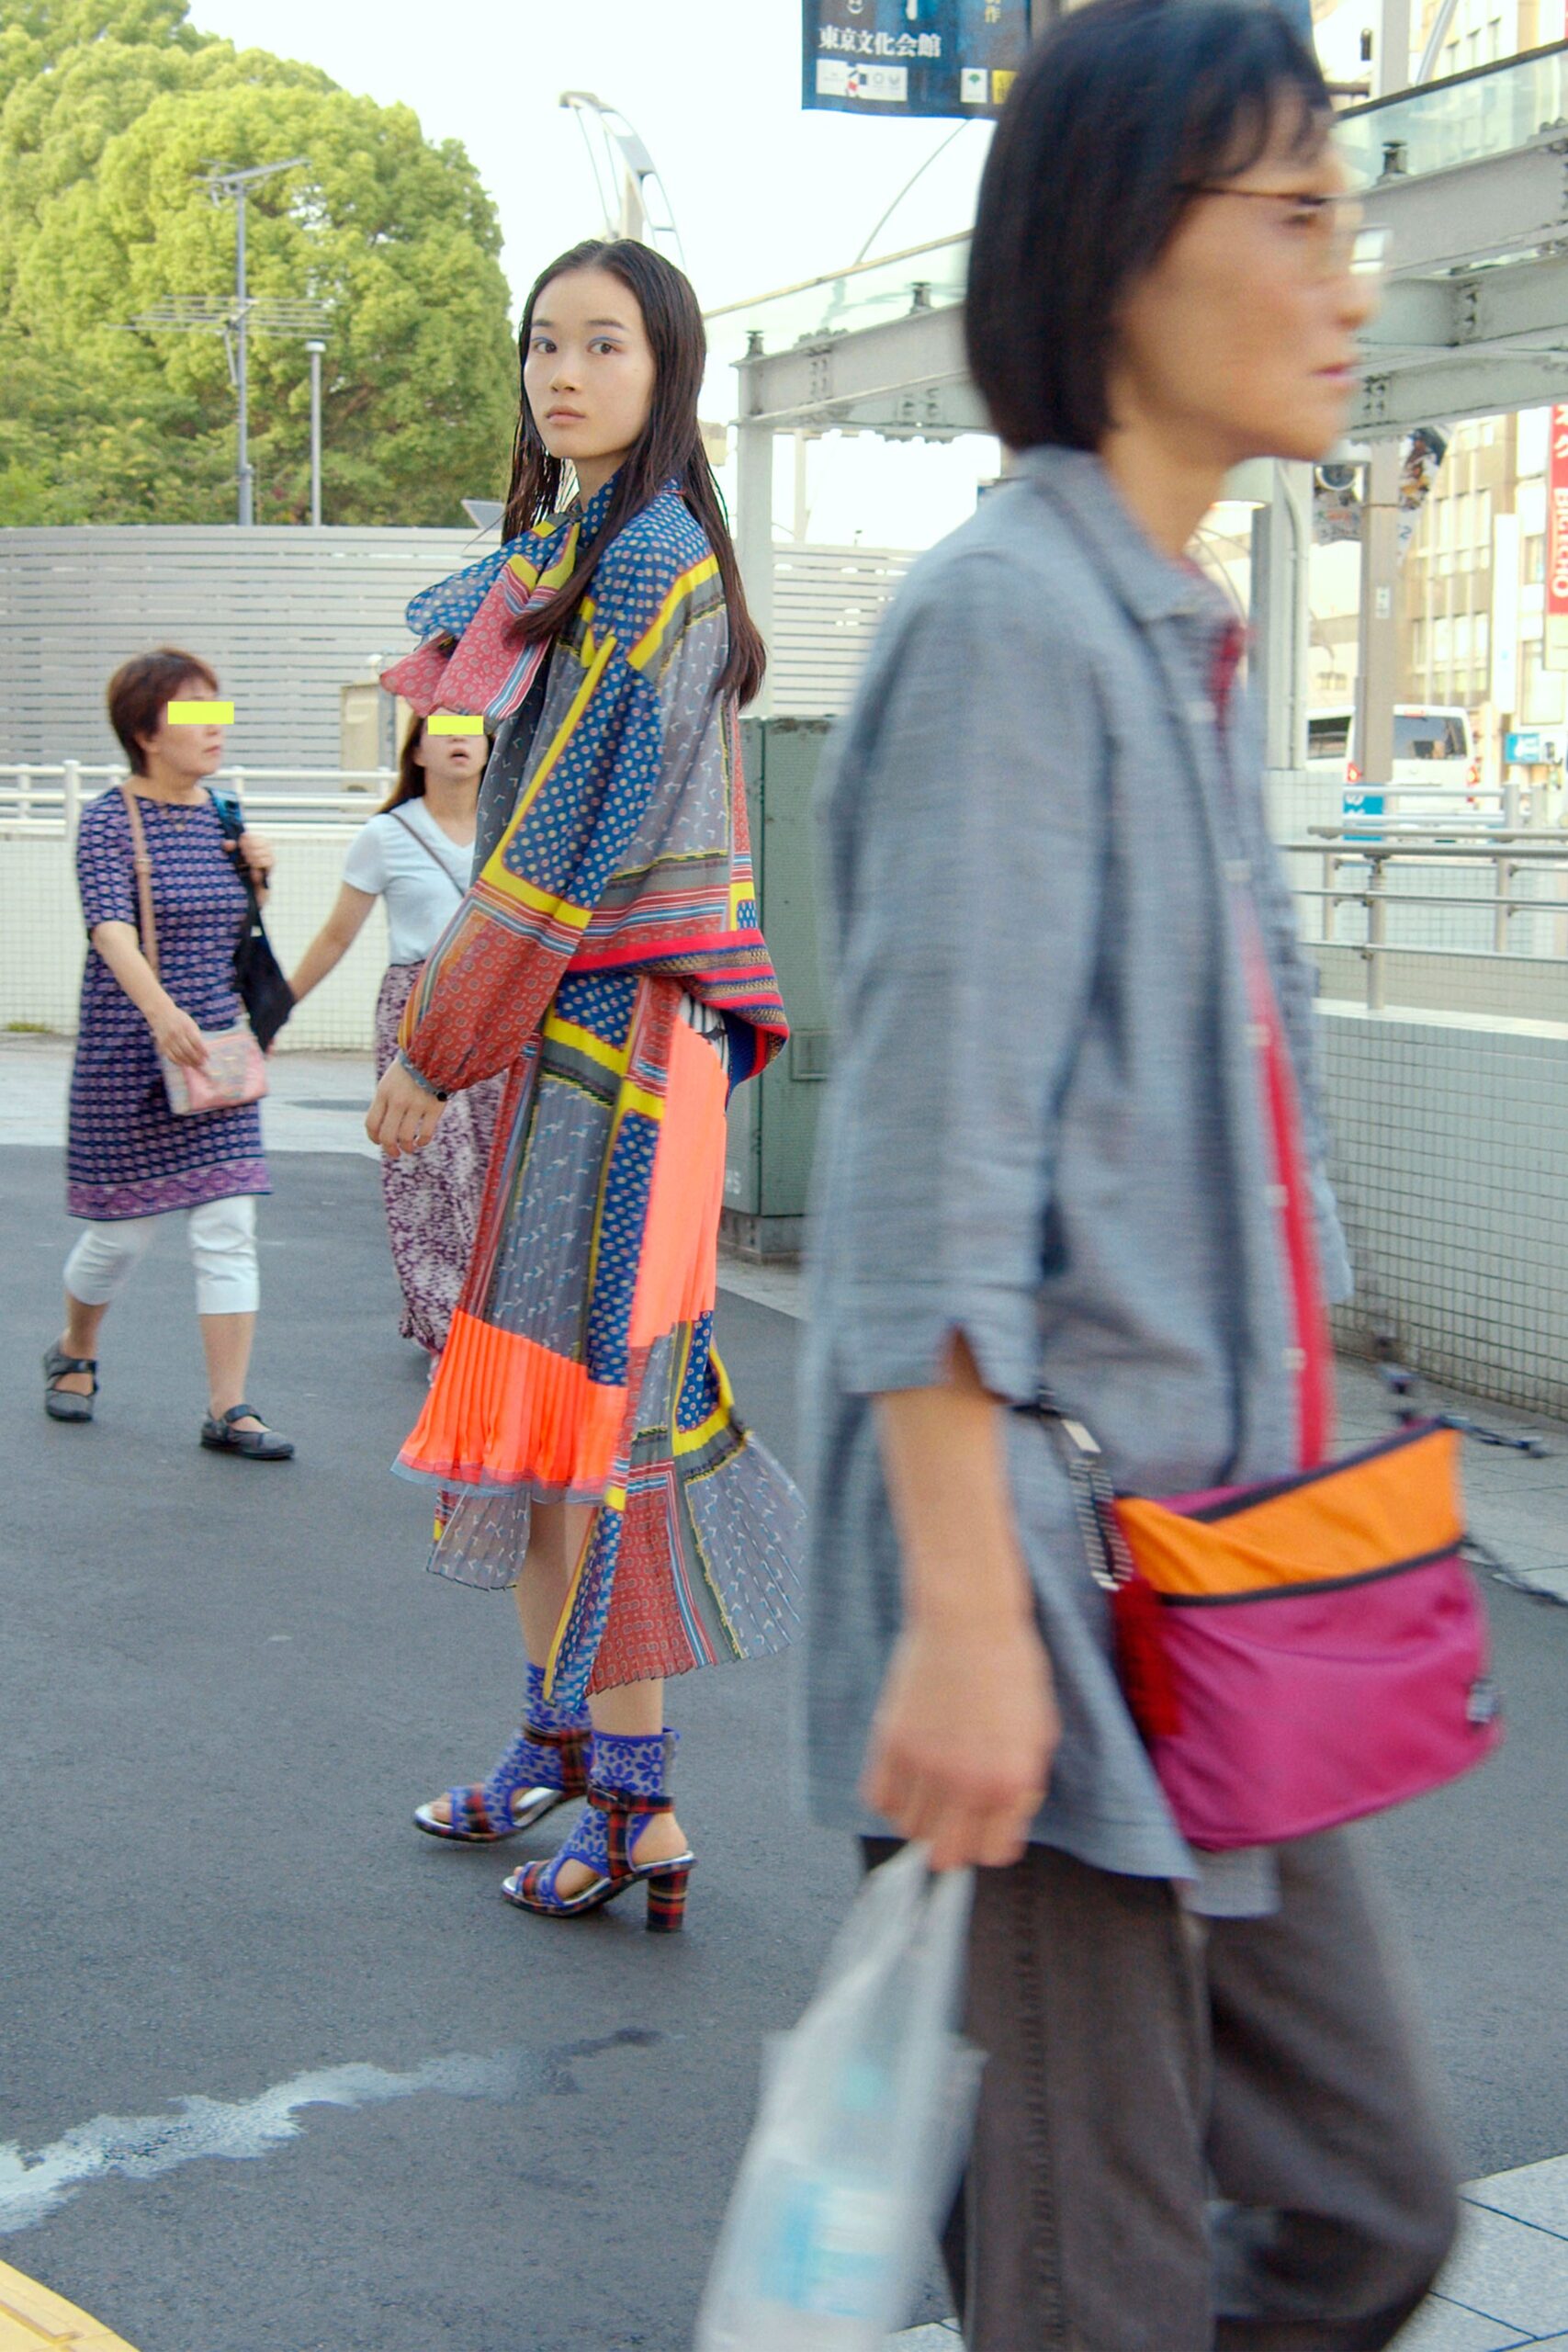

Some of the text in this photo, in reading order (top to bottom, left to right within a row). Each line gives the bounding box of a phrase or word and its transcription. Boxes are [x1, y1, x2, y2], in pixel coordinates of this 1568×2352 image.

[818, 25, 942, 57] 東京文化会館
